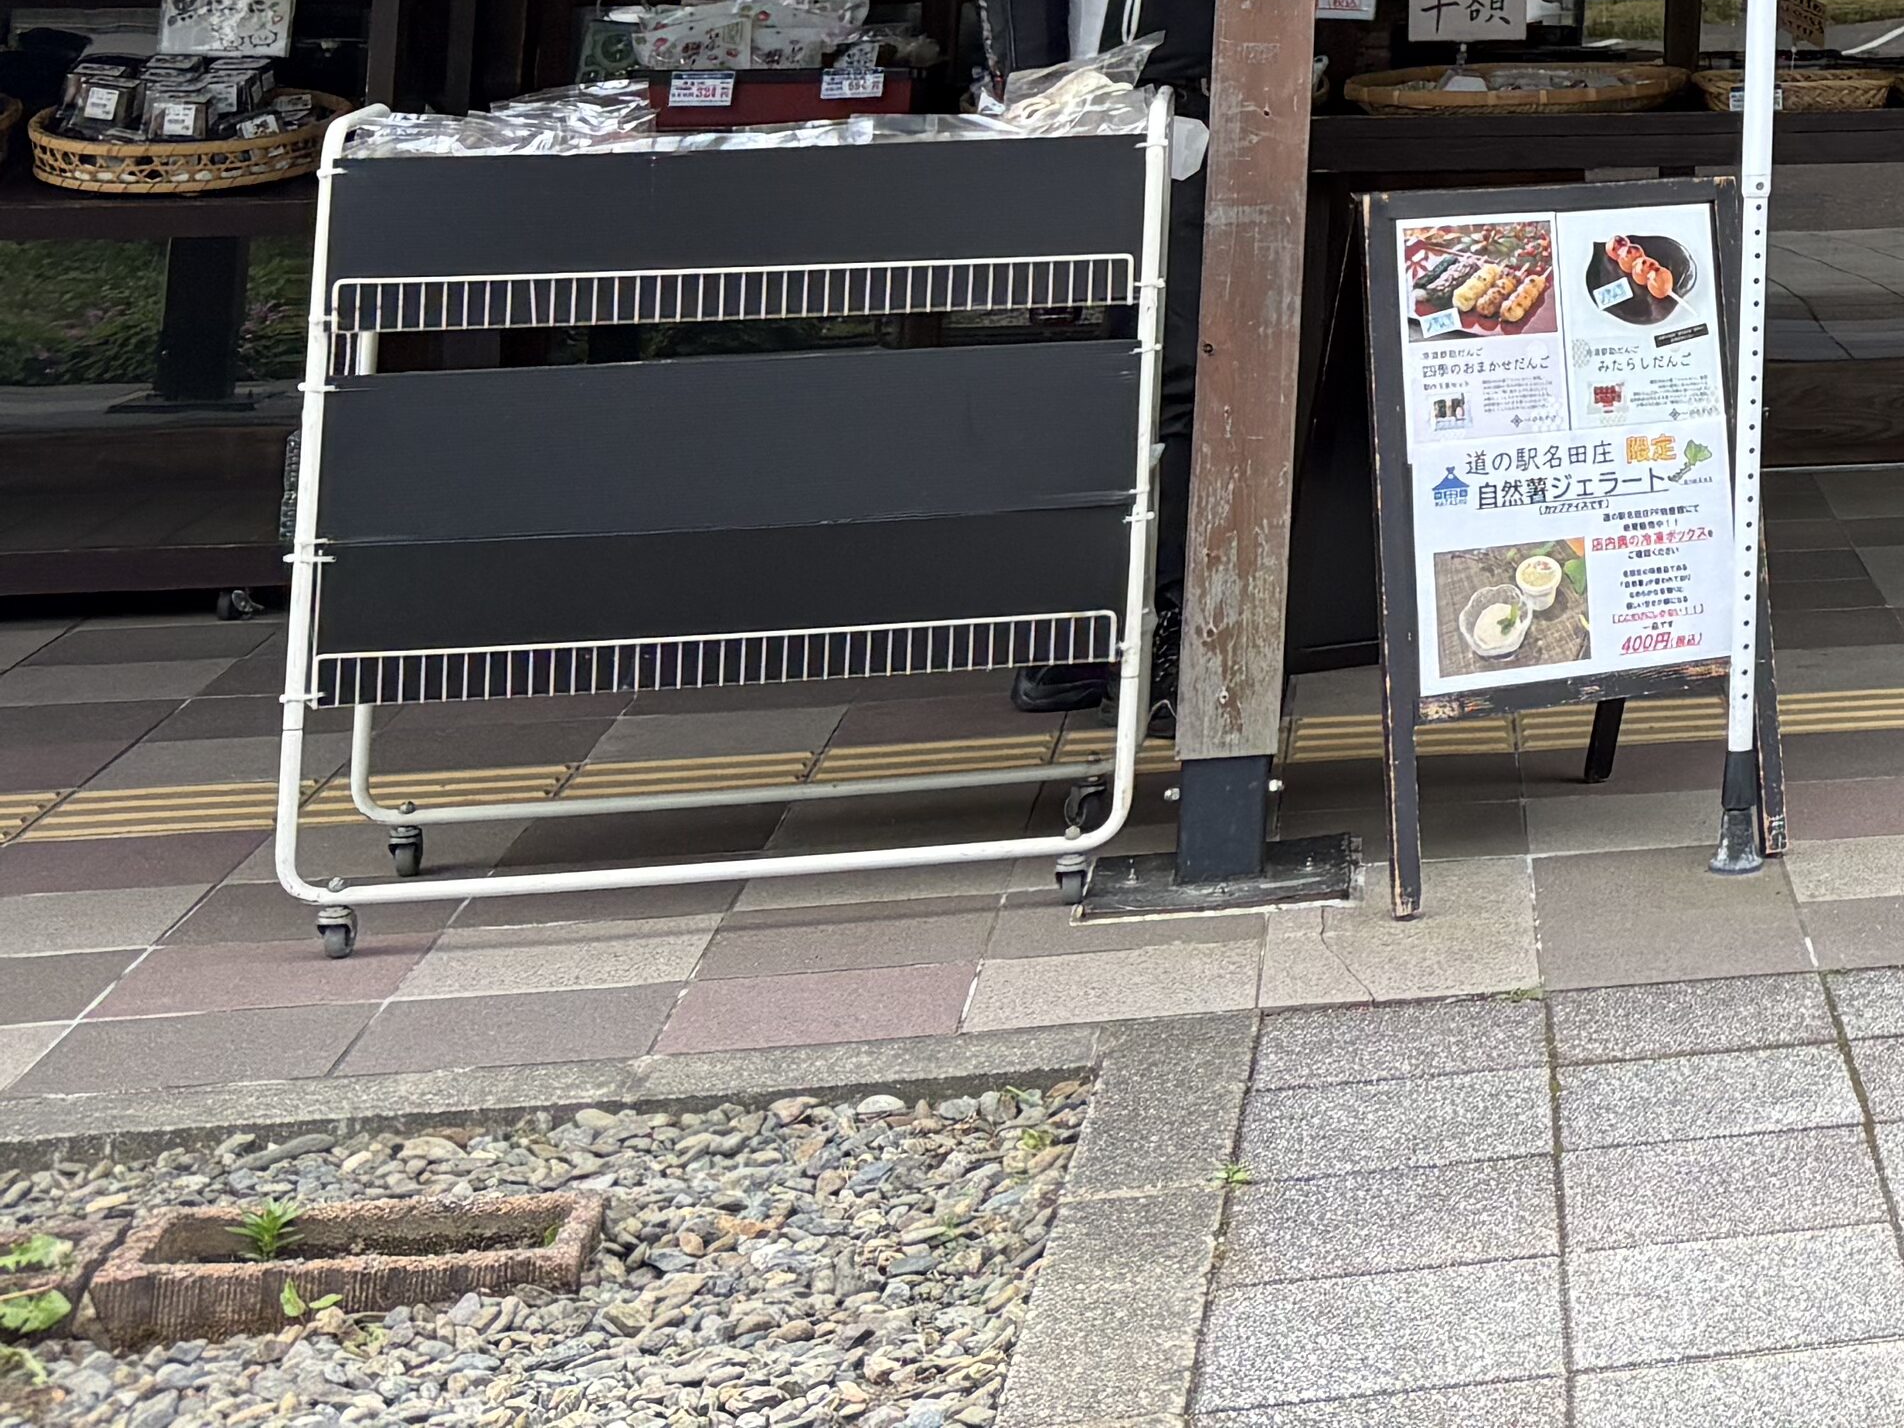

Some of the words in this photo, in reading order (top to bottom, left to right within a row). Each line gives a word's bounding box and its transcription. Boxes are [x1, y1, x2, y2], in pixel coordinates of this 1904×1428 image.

[1422, 355, 1550, 378] 四季のおまかせだんご
[1598, 352, 1692, 372] みたらしだんご
[1465, 442, 1614, 475] 道の駅名田庄
[1626, 435, 1676, 464] 限定
[1478, 467, 1665, 508] 自然薯ジェラート
[1621, 631, 1702, 654] 400円(税込)
